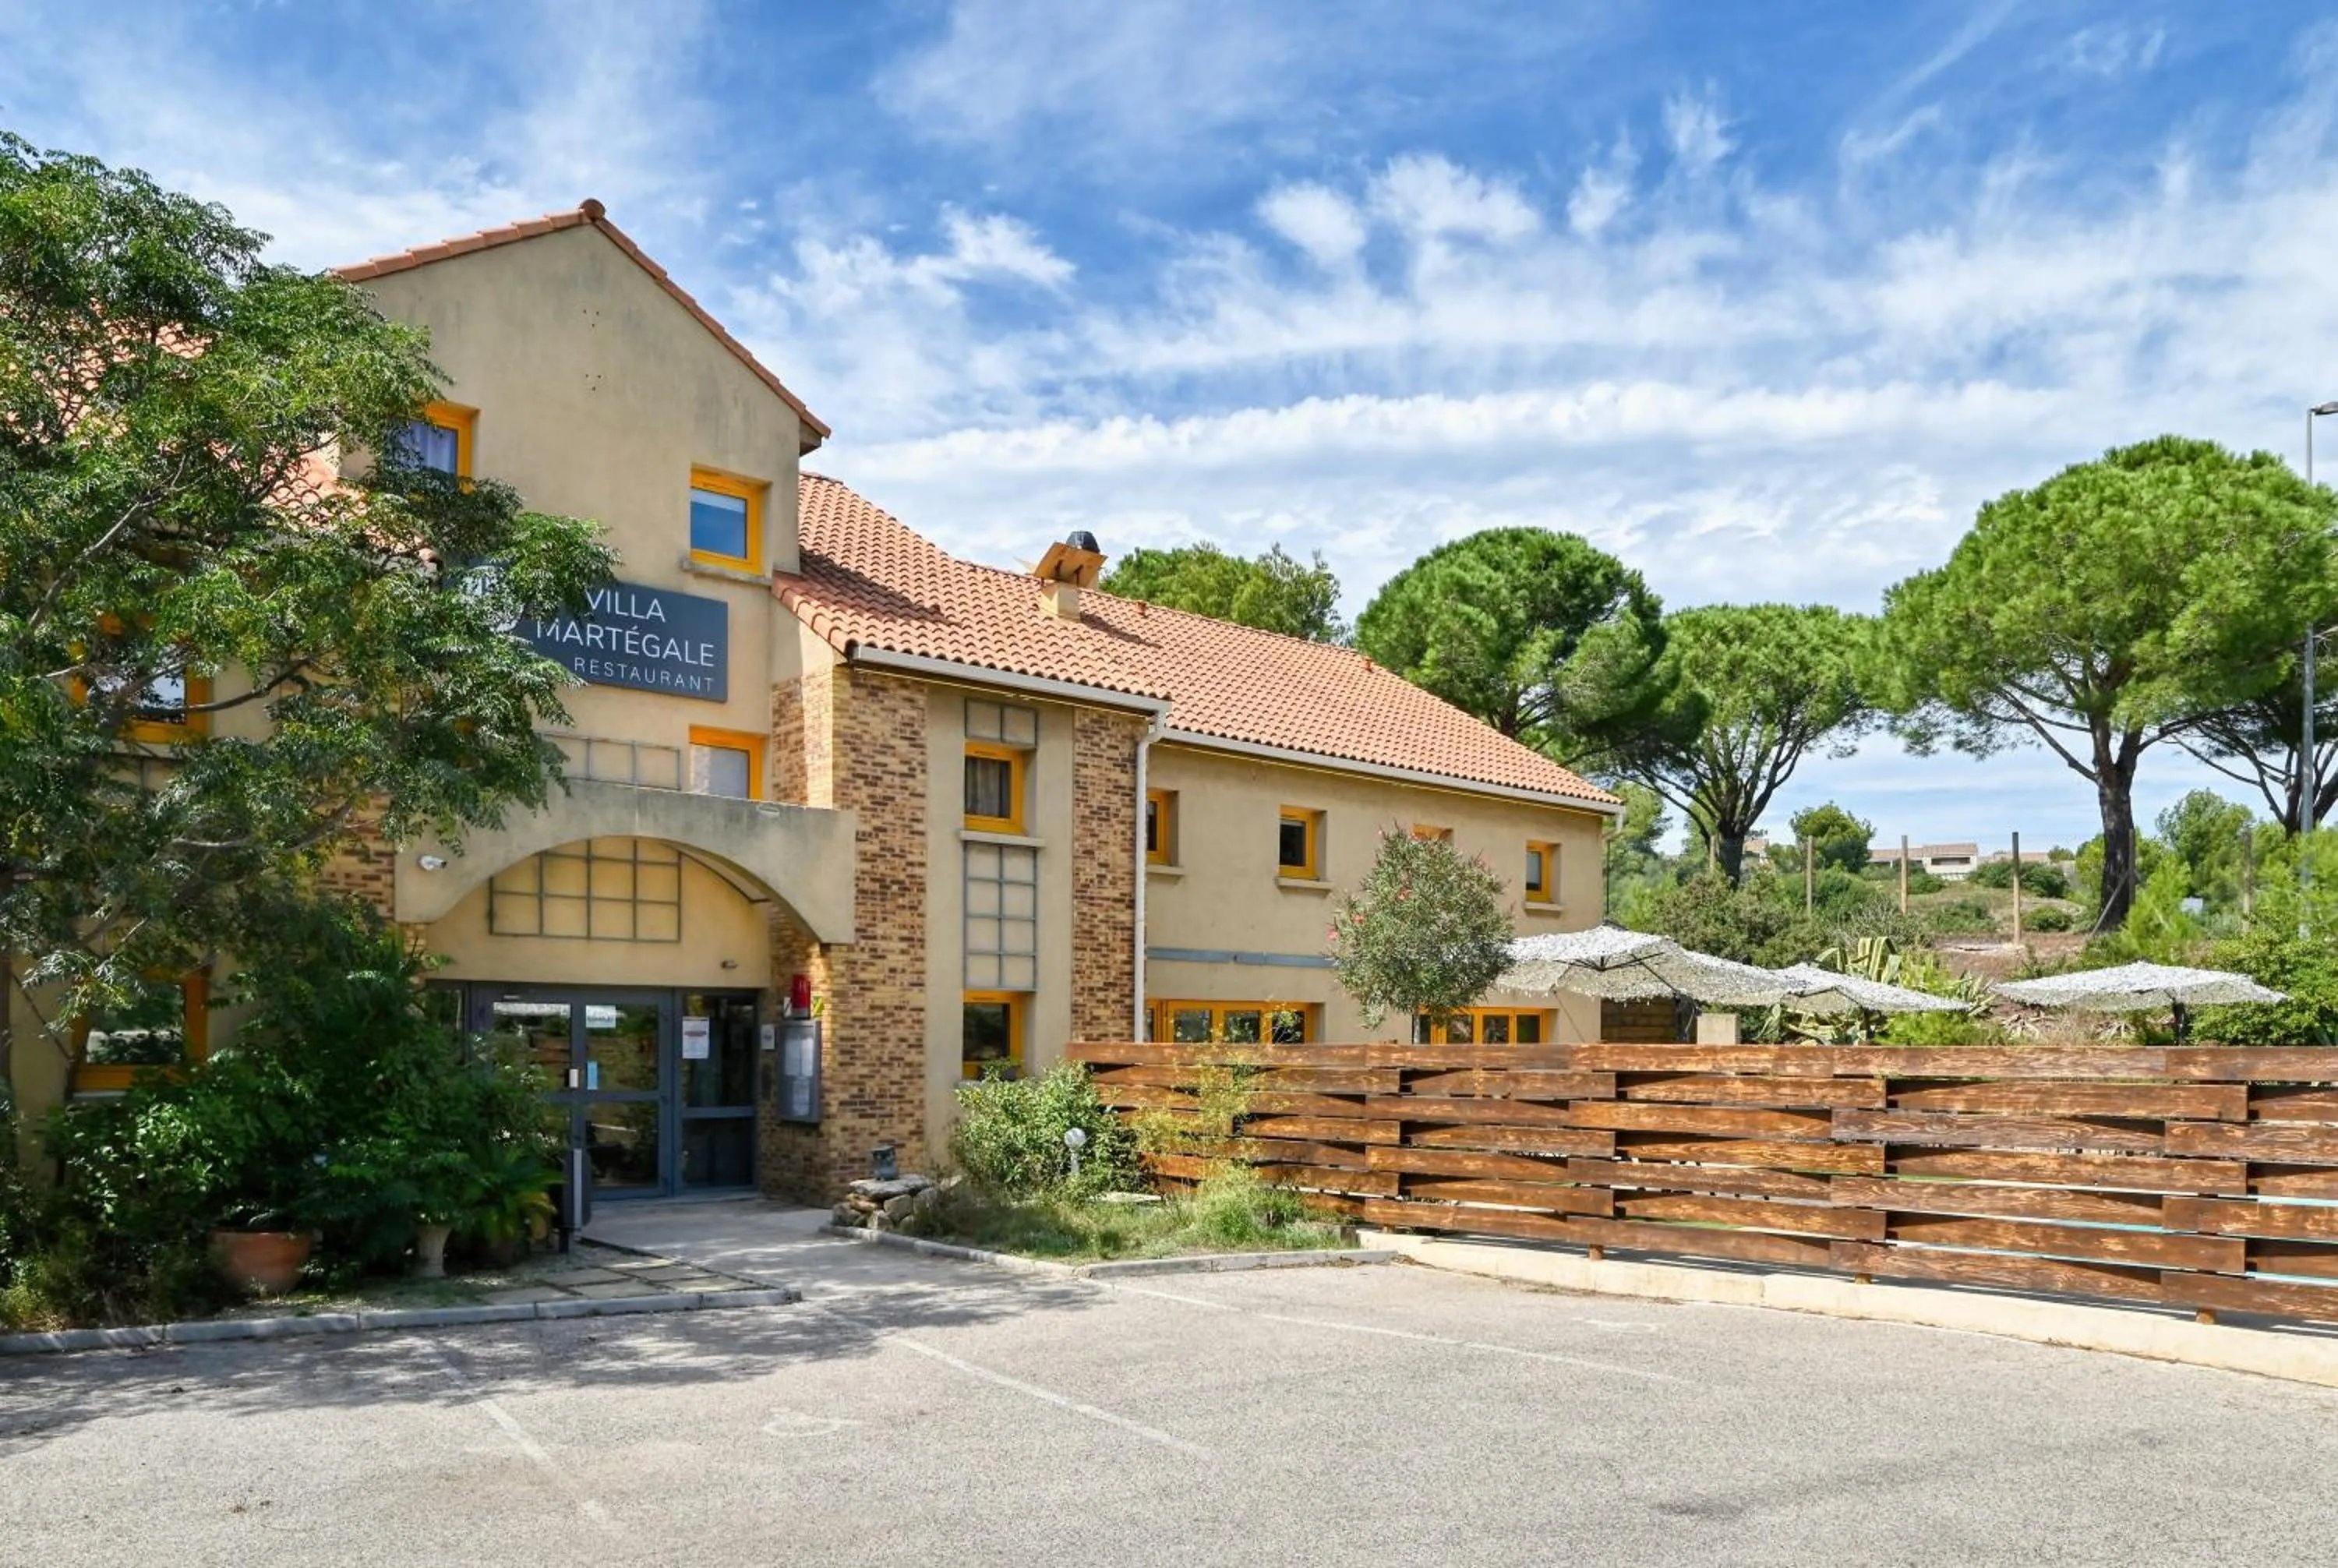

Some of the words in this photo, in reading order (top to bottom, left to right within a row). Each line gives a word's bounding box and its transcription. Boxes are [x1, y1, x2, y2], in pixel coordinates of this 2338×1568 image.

[584, 588, 666, 623] VILLA
[537, 618, 715, 666] MARTÉGALE
[574, 657, 714, 691] RESTAURANT
